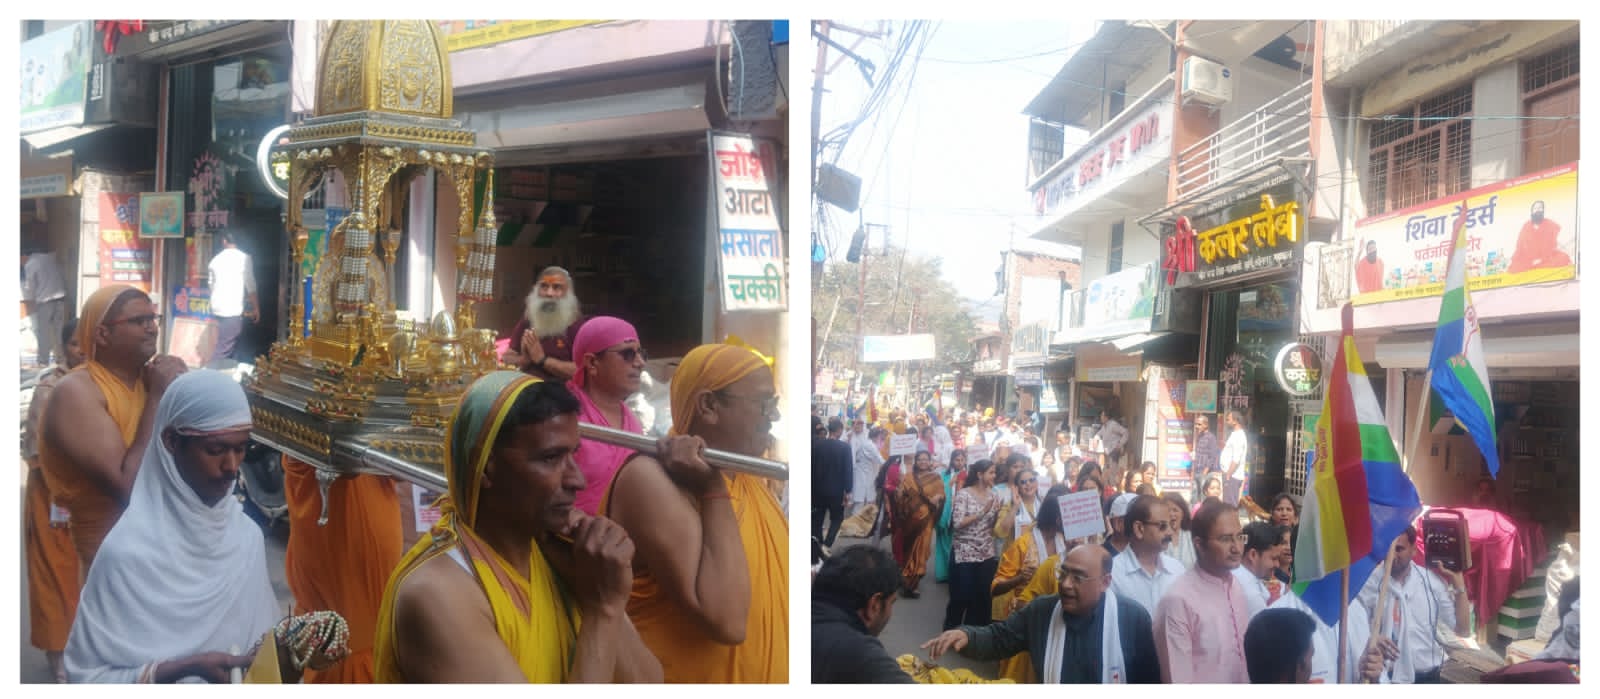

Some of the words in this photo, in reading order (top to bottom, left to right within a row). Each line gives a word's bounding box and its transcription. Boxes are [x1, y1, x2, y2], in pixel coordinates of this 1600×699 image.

[725, 186, 770, 216] आटा
[720, 228, 781, 258] मसाला
[1406, 215, 1447, 242] शिवा
[1161, 215, 1197, 286] श्री
[1197, 217, 1251, 264] कलर
[728, 262, 782, 304] चक्की
